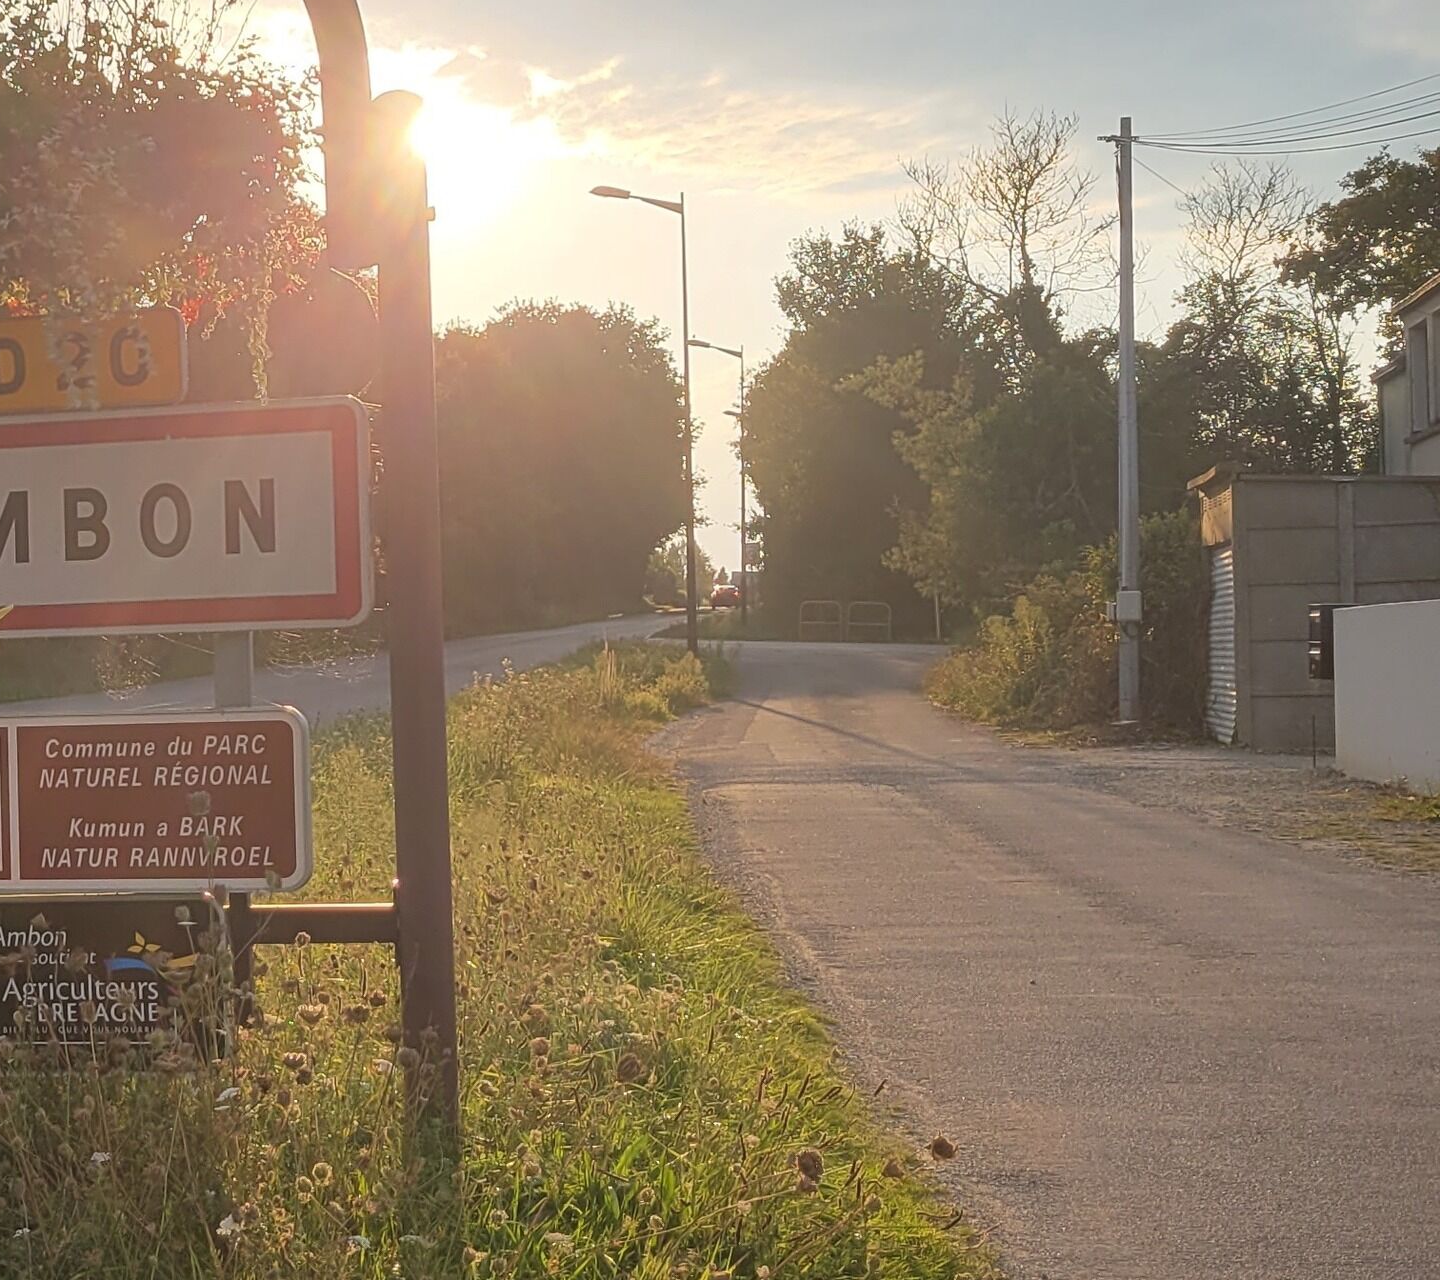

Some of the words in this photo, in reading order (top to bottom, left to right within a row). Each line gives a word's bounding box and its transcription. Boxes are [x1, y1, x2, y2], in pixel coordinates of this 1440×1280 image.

[45, 738, 155, 758] Commune
[167, 736, 192, 756] du
[203, 734, 266, 755] PARC
[39, 767, 142, 789] NATUREL
[154, 761, 272, 786] RÉGIONAL
[69, 818, 145, 838] Kumun
[156, 822, 169, 837] a
[179, 816, 244, 837] BARK
[41, 848, 118, 868] NATUR
[129, 846, 274, 867] RANNVROEL
[2, 974, 159, 1007] Agriculteurs
[38, 1002, 159, 1022] BREAGNE
